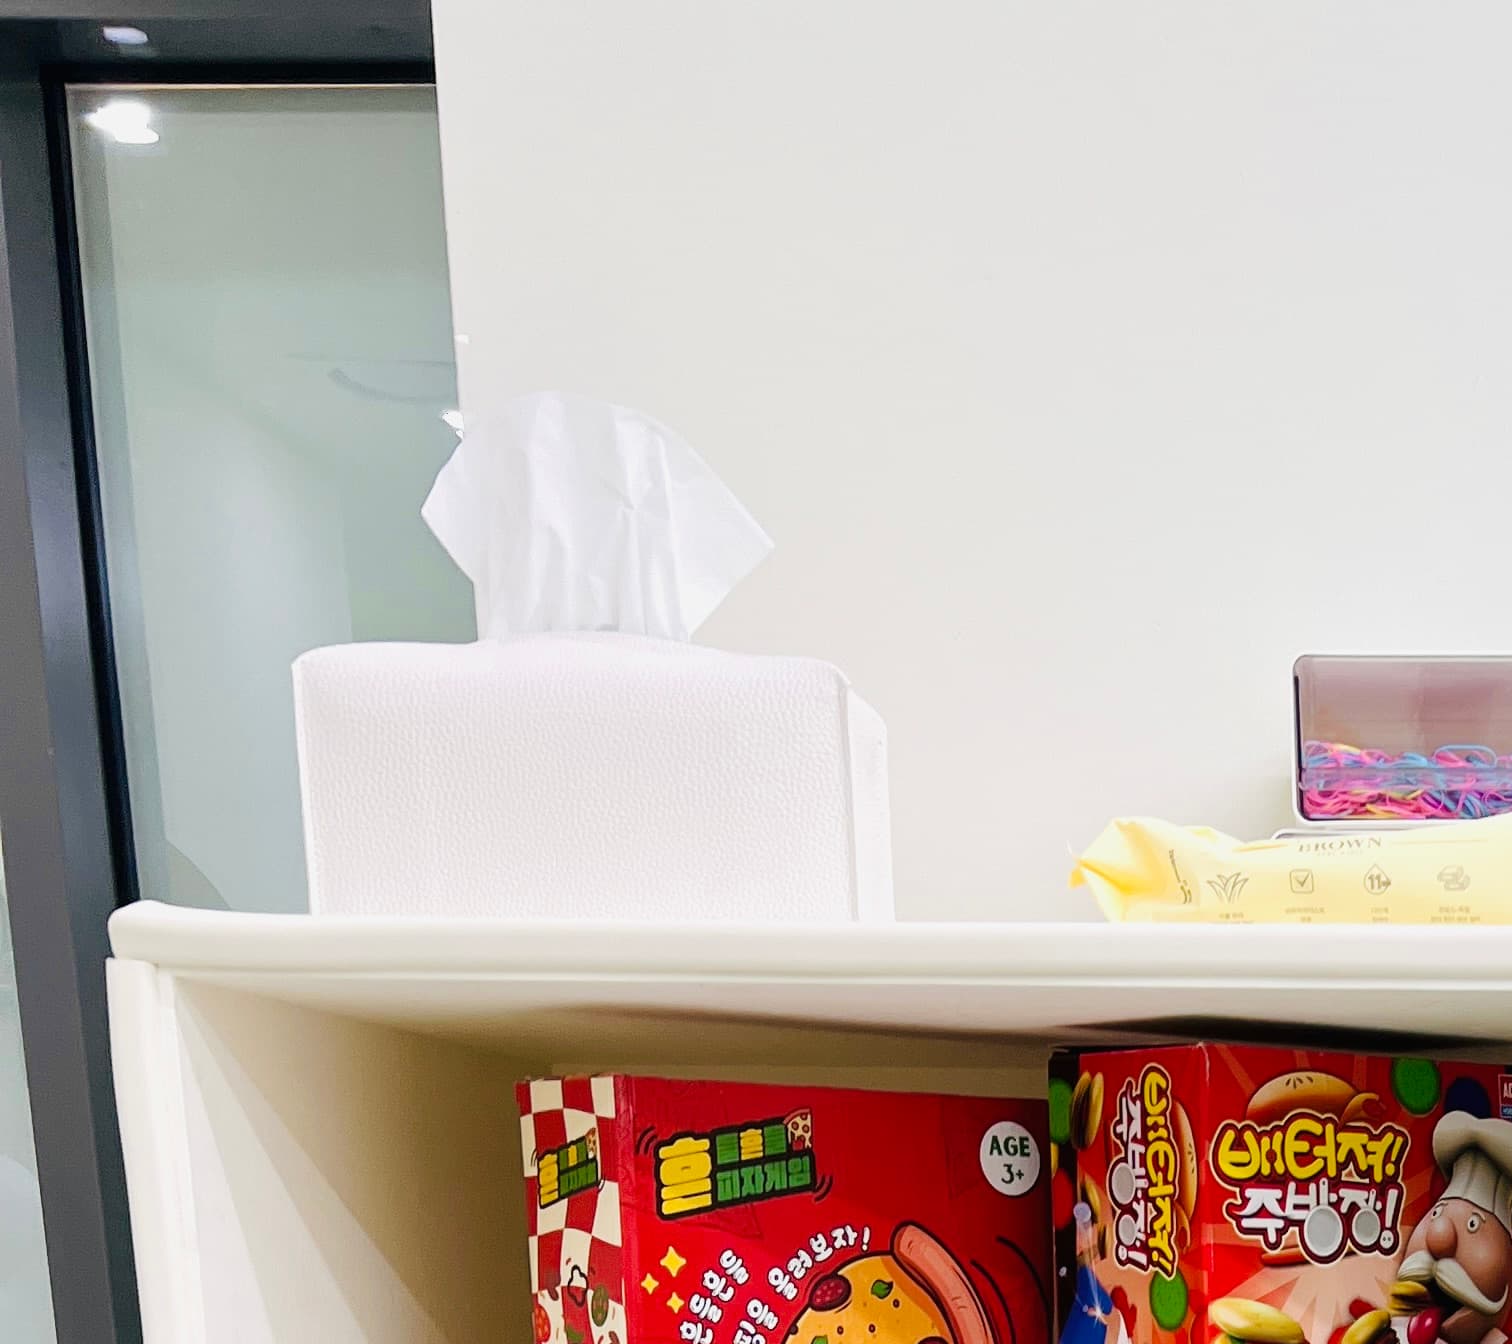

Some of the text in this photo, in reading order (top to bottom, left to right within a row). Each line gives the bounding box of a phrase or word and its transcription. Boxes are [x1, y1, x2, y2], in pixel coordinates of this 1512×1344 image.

[989, 1135, 1032, 1158] AGE
[1000, 1163, 1026, 1185] 3+
[1213, 1120, 1406, 1183] 배터져!
[715, 1155, 812, 1203] 피자게임
[1110, 1078, 1148, 1271] 주방장!
[1237, 1180, 1399, 1255] 주방장!
